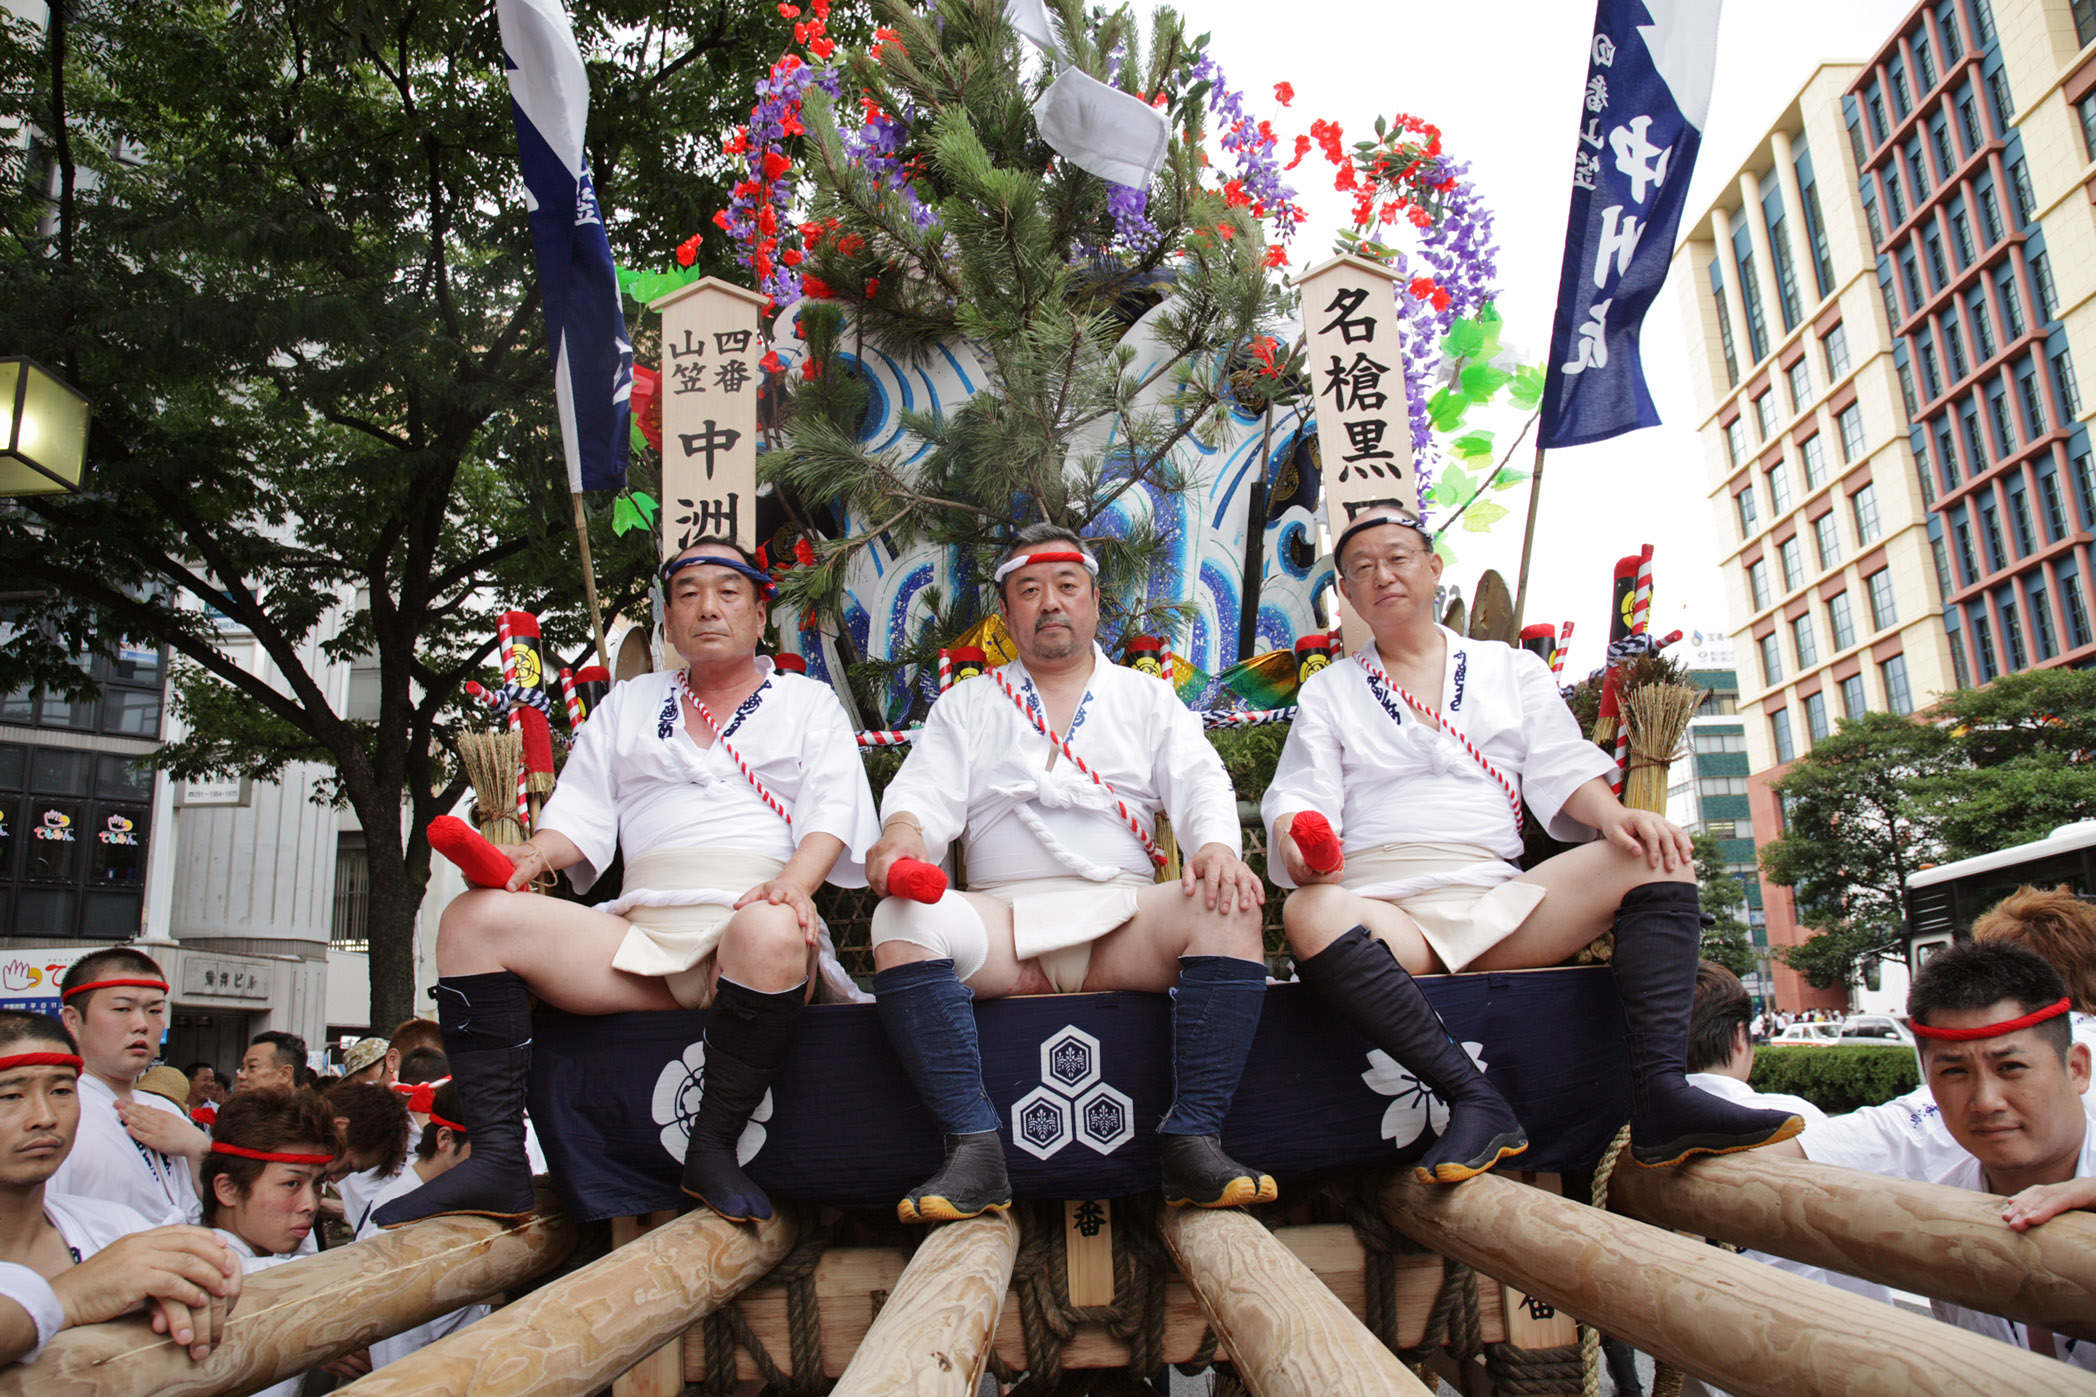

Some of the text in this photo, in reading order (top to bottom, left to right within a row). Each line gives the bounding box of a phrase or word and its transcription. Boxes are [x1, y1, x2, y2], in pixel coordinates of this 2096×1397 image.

[669, 329, 707, 395] 山笠
[713, 329, 753, 394] 四番
[1318, 288, 1404, 523] 名槍黒
[675, 420, 741, 550] 中洲
[34, 827, 75, 841] てもみん
[98, 831, 138, 845] てもみん
[45, 964, 67, 987] て
[1073, 1200, 1107, 1237] 番
